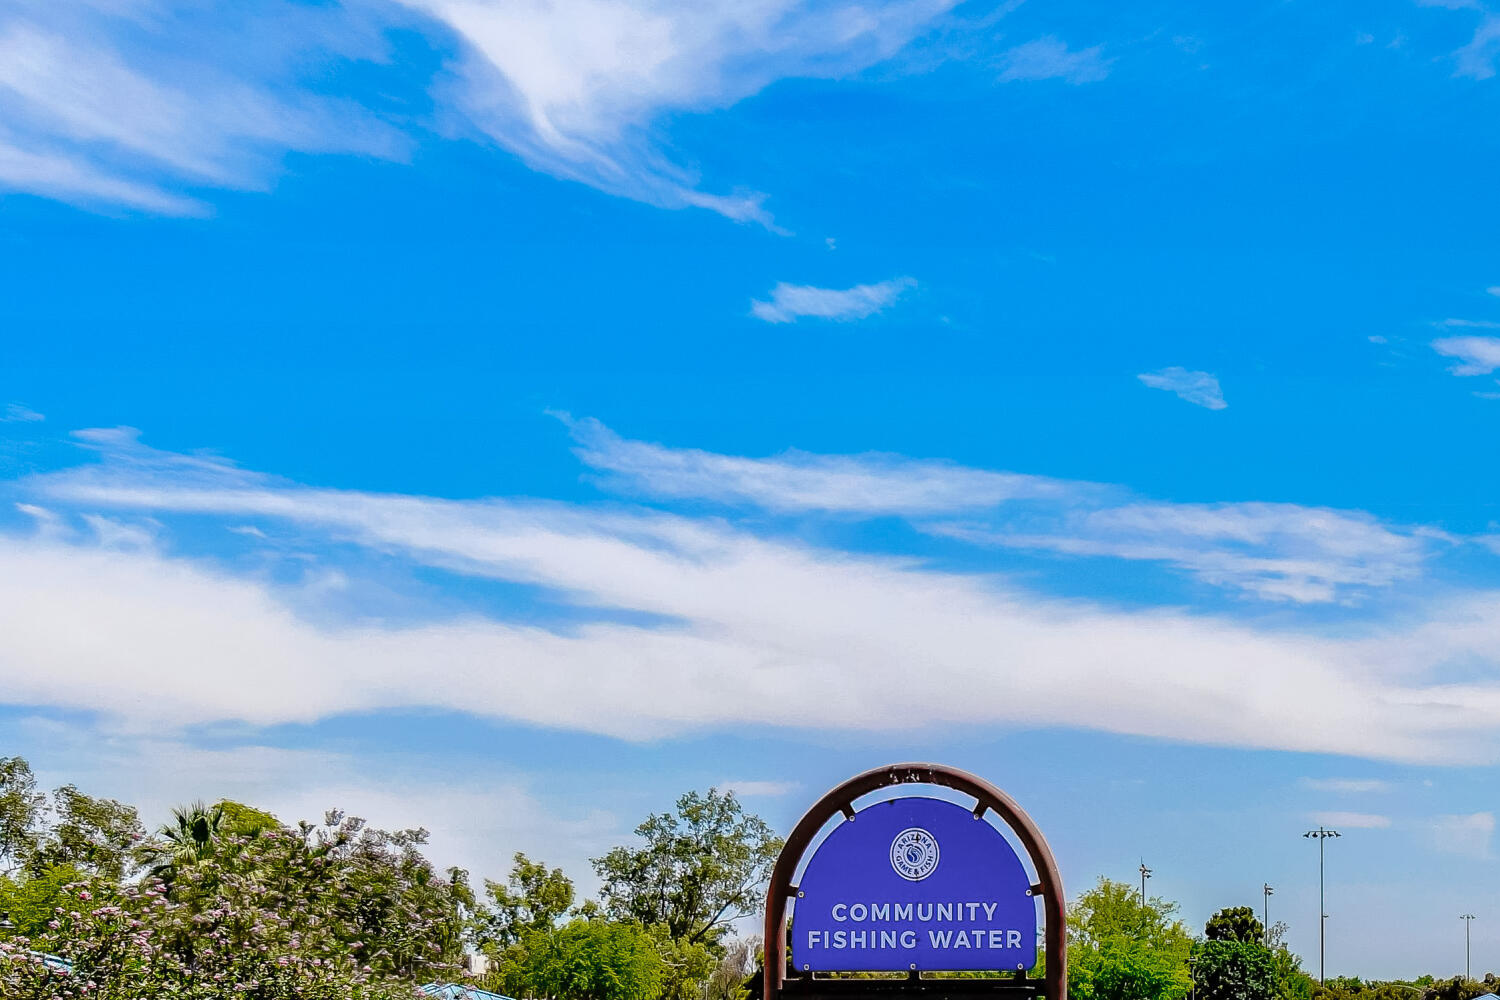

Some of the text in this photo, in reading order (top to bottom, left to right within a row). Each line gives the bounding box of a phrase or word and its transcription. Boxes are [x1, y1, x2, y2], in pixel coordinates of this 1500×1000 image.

[897, 833, 933, 850] ARIZONA
[896, 855, 934, 876] GAME & FISH
[831, 902, 998, 922] COMMUNITY
[807, 930, 1022, 949] FISHING WATER
